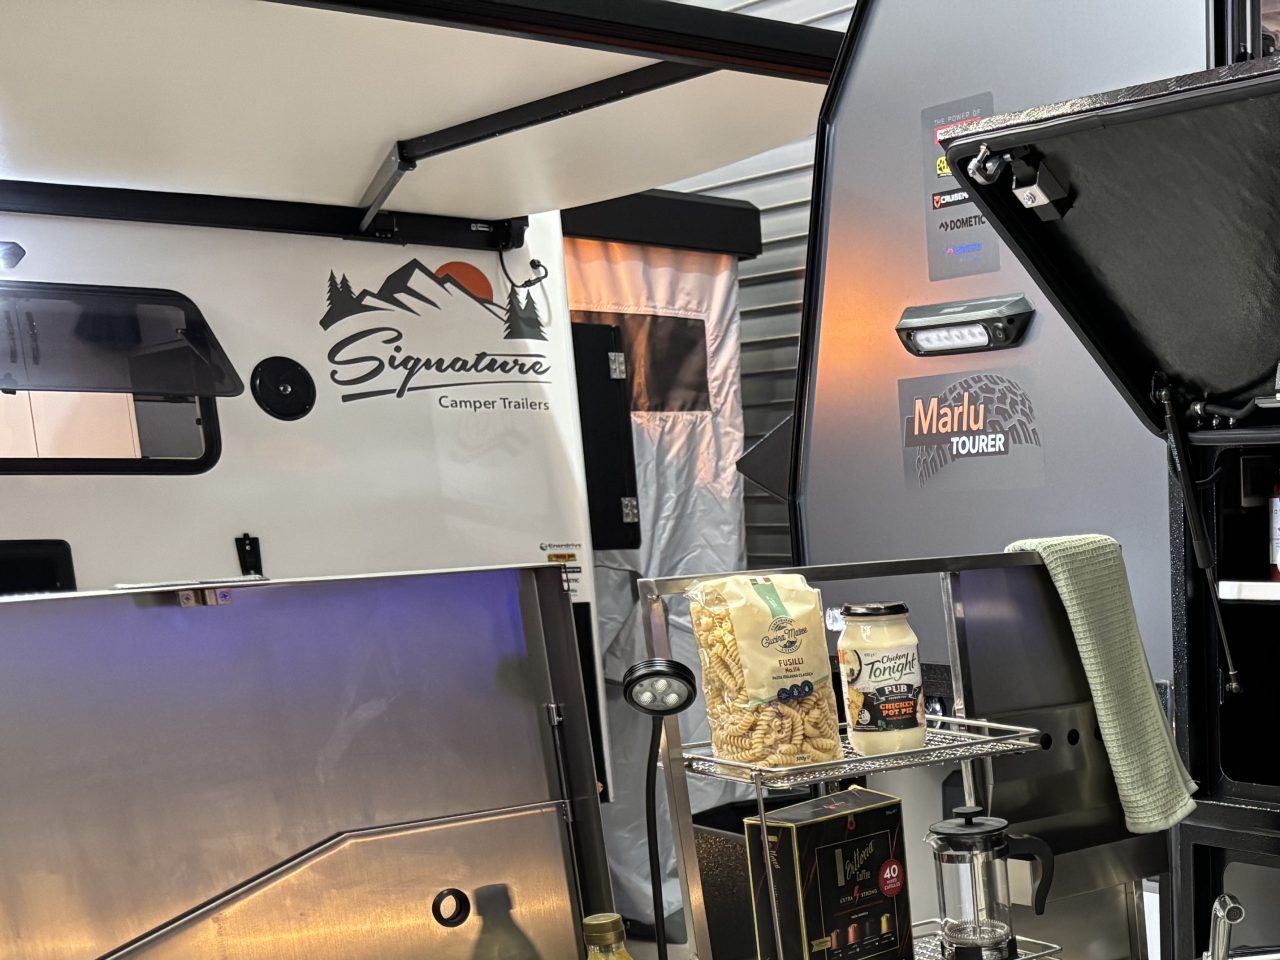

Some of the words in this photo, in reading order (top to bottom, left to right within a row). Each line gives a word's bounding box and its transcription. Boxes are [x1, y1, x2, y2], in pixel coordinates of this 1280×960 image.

[934, 117, 946, 125] THE
[947, 111, 970, 122] POWER
[972, 109, 982, 117] OF
[949, 214, 986, 231] DOMETIC
[327, 326, 551, 398] Signature
[438, 395, 497, 412] Camper
[500, 397, 550, 411] Trailers
[914, 391, 985, 436] Marlu
[951, 433, 1005, 455] TOURER
[778, 657, 804, 667] FUSILLI
[864, 652, 917, 681] Tonight
[881, 652, 907, 665] Chicken
[884, 684, 908, 695] PUB
[880, 700, 914, 710] CHICKEN
[882, 709, 899, 717] POT
[901, 706, 913, 715] PIE
[883, 864, 899, 879] 40
[840, 895, 853, 904] EXTRA
[861, 888, 878, 898] STRONG
